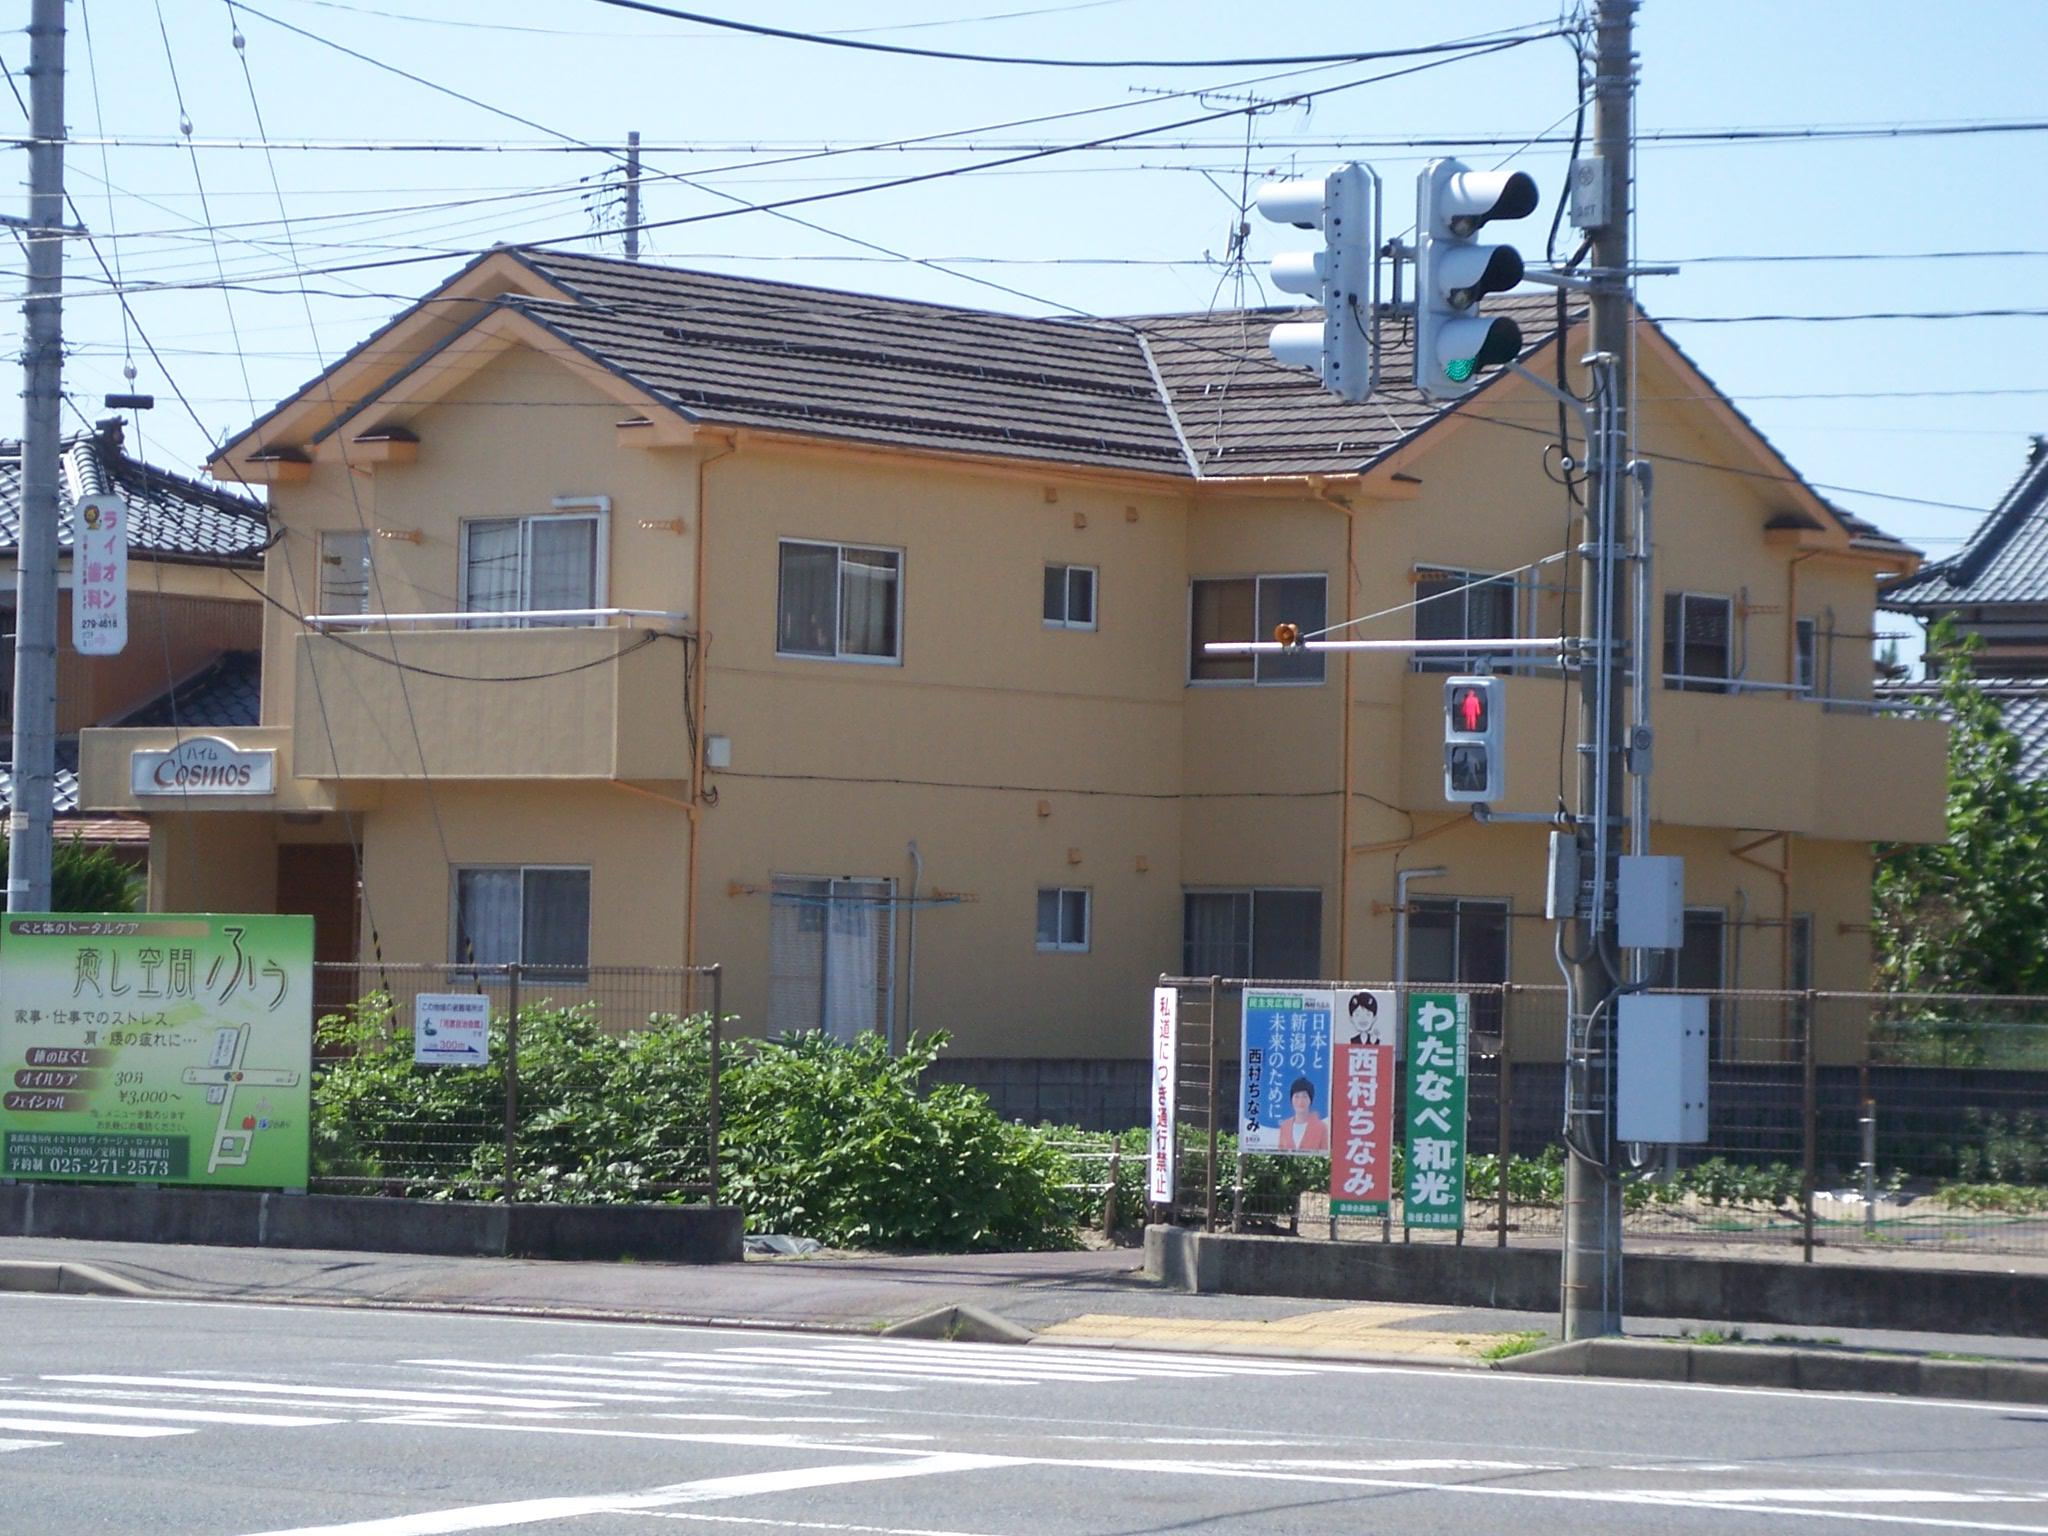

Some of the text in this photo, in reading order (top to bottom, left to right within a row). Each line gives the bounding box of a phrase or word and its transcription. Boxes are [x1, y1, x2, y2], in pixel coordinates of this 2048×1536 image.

[103, 511, 118, 609] ライオン
[87, 561, 102, 610] 歯科
[186, 747, 218, 760] ハイム
[18, 922, 139, 935] 心と体のトータルケア
[1268, 1012, 1286, 1118] 未来のために
[1309, 1012, 1328, 1069] 日本と
[9, 1094, 65, 1110] フェイシャル
[20, 1072, 79, 1087] オイルケア
[114, 1071, 144, 1086] 30分
[1156, 996, 1171, 1195] 私道につき通行禁止
[1246, 1048, 1263, 1133] 西村ちなみ
[1342, 1047, 1379, 1197] 西村ちなみ
[1411, 1000, 1455, 1207] わたなべ和光
[9, 1145, 36, 1156] OPEN
[129, 1147, 170, 1159] 毎週日曜日
[11, 1158, 169, 1176] 予約制 025-271-2573
